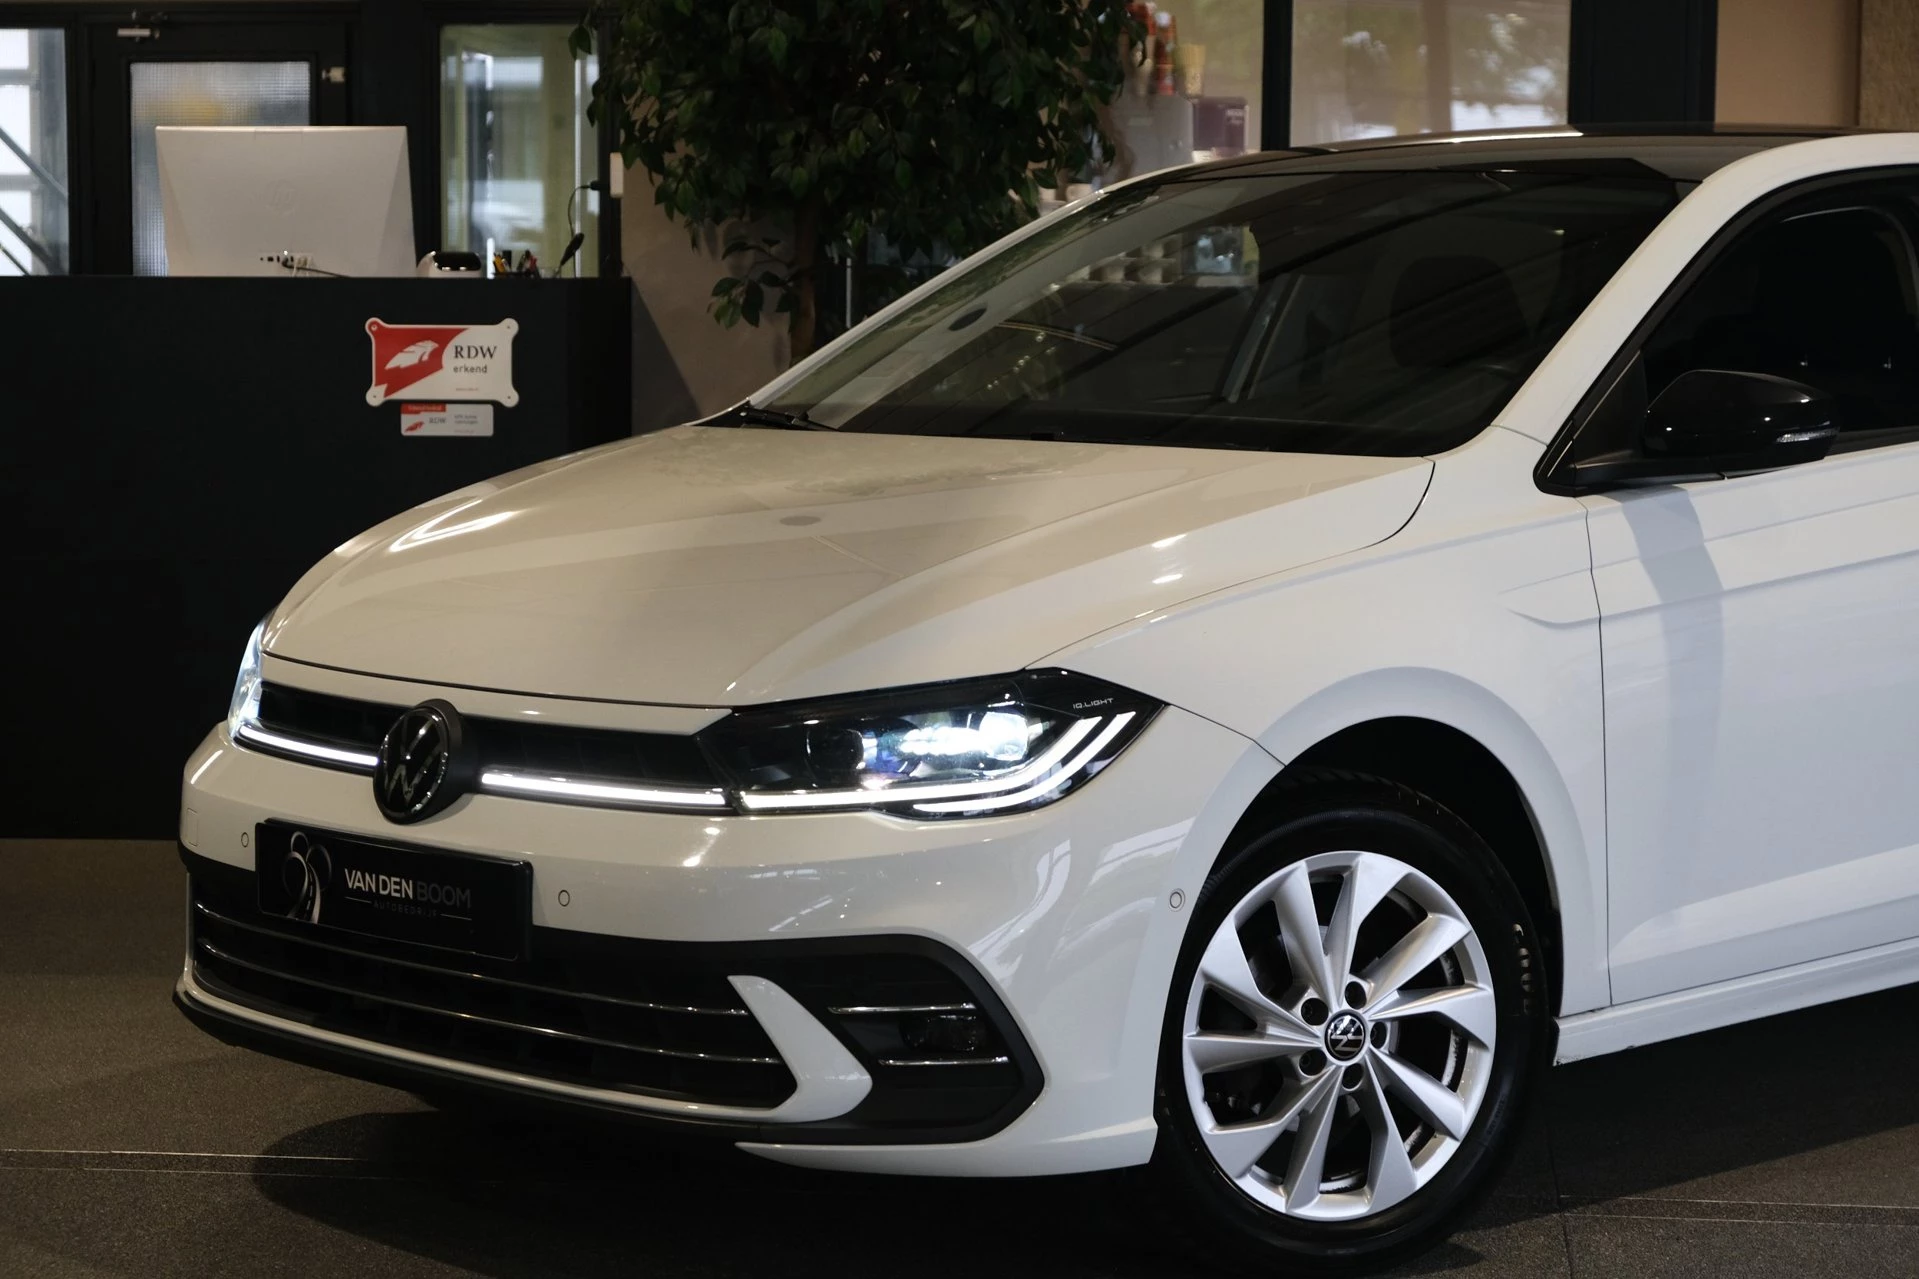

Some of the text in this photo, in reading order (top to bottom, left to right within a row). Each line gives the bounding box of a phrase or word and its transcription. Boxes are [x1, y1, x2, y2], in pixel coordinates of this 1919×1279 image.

[453, 345, 498, 359] RDW
[453, 364, 488, 374] erkend
[1072, 698, 1114, 709] IQ.LIGHT
[344, 867, 471, 908] VAN DEN BOOM
[373, 900, 438, 918] AUTOBEDRIJF
